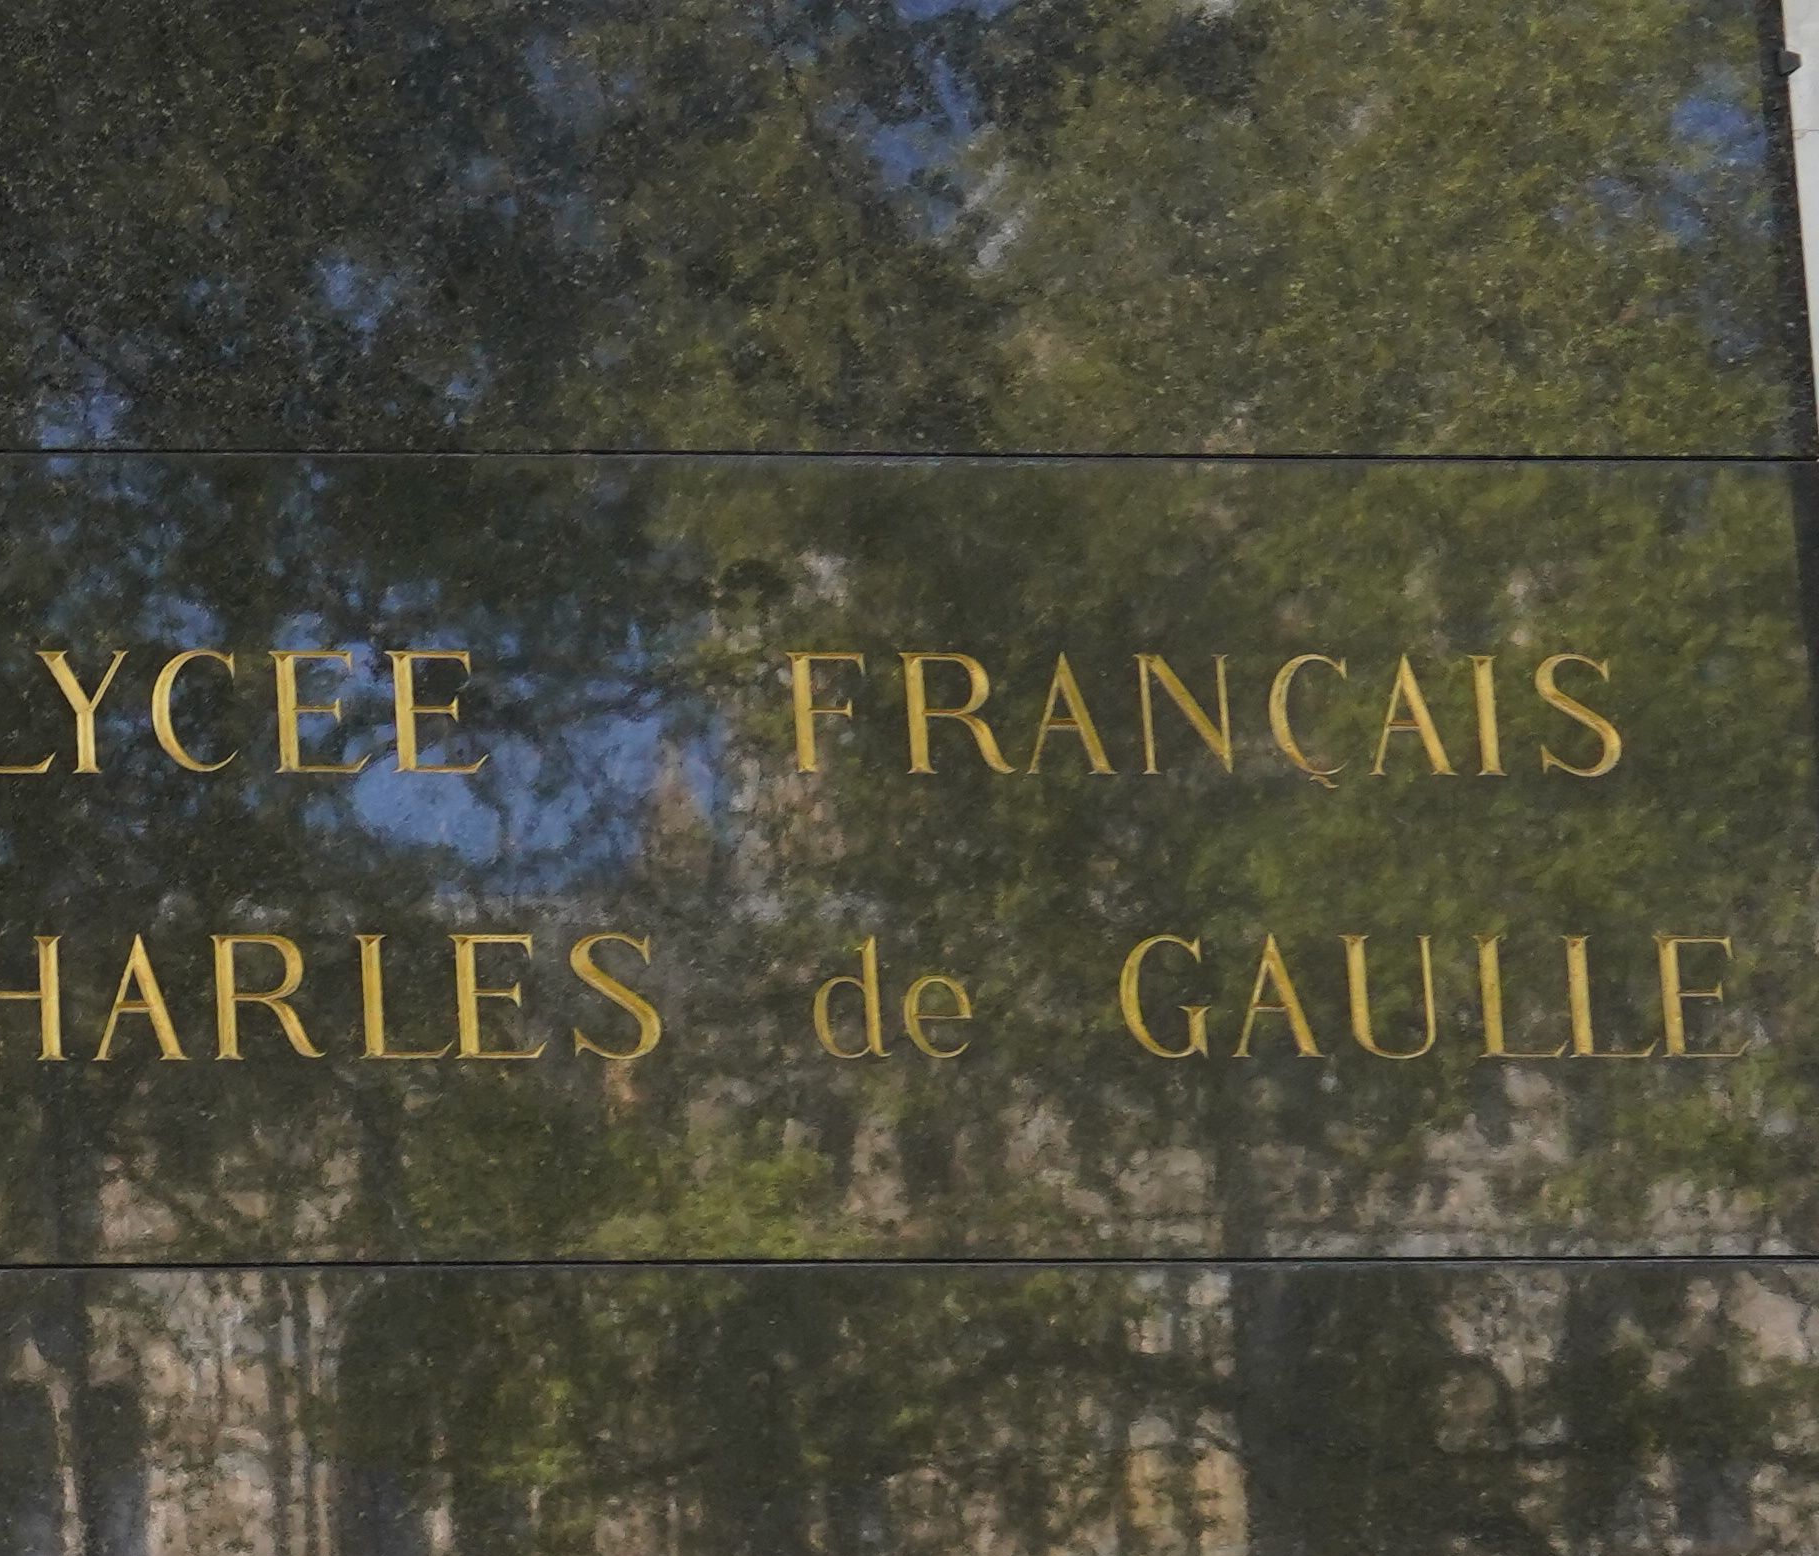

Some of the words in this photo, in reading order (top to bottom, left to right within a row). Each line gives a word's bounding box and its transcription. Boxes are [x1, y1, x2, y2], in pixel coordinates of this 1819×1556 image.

[785, 650, 1624, 789] FRANÇAIS
[811, 933, 974, 1060] de
[1118, 932, 1751, 1060] GAULLE
